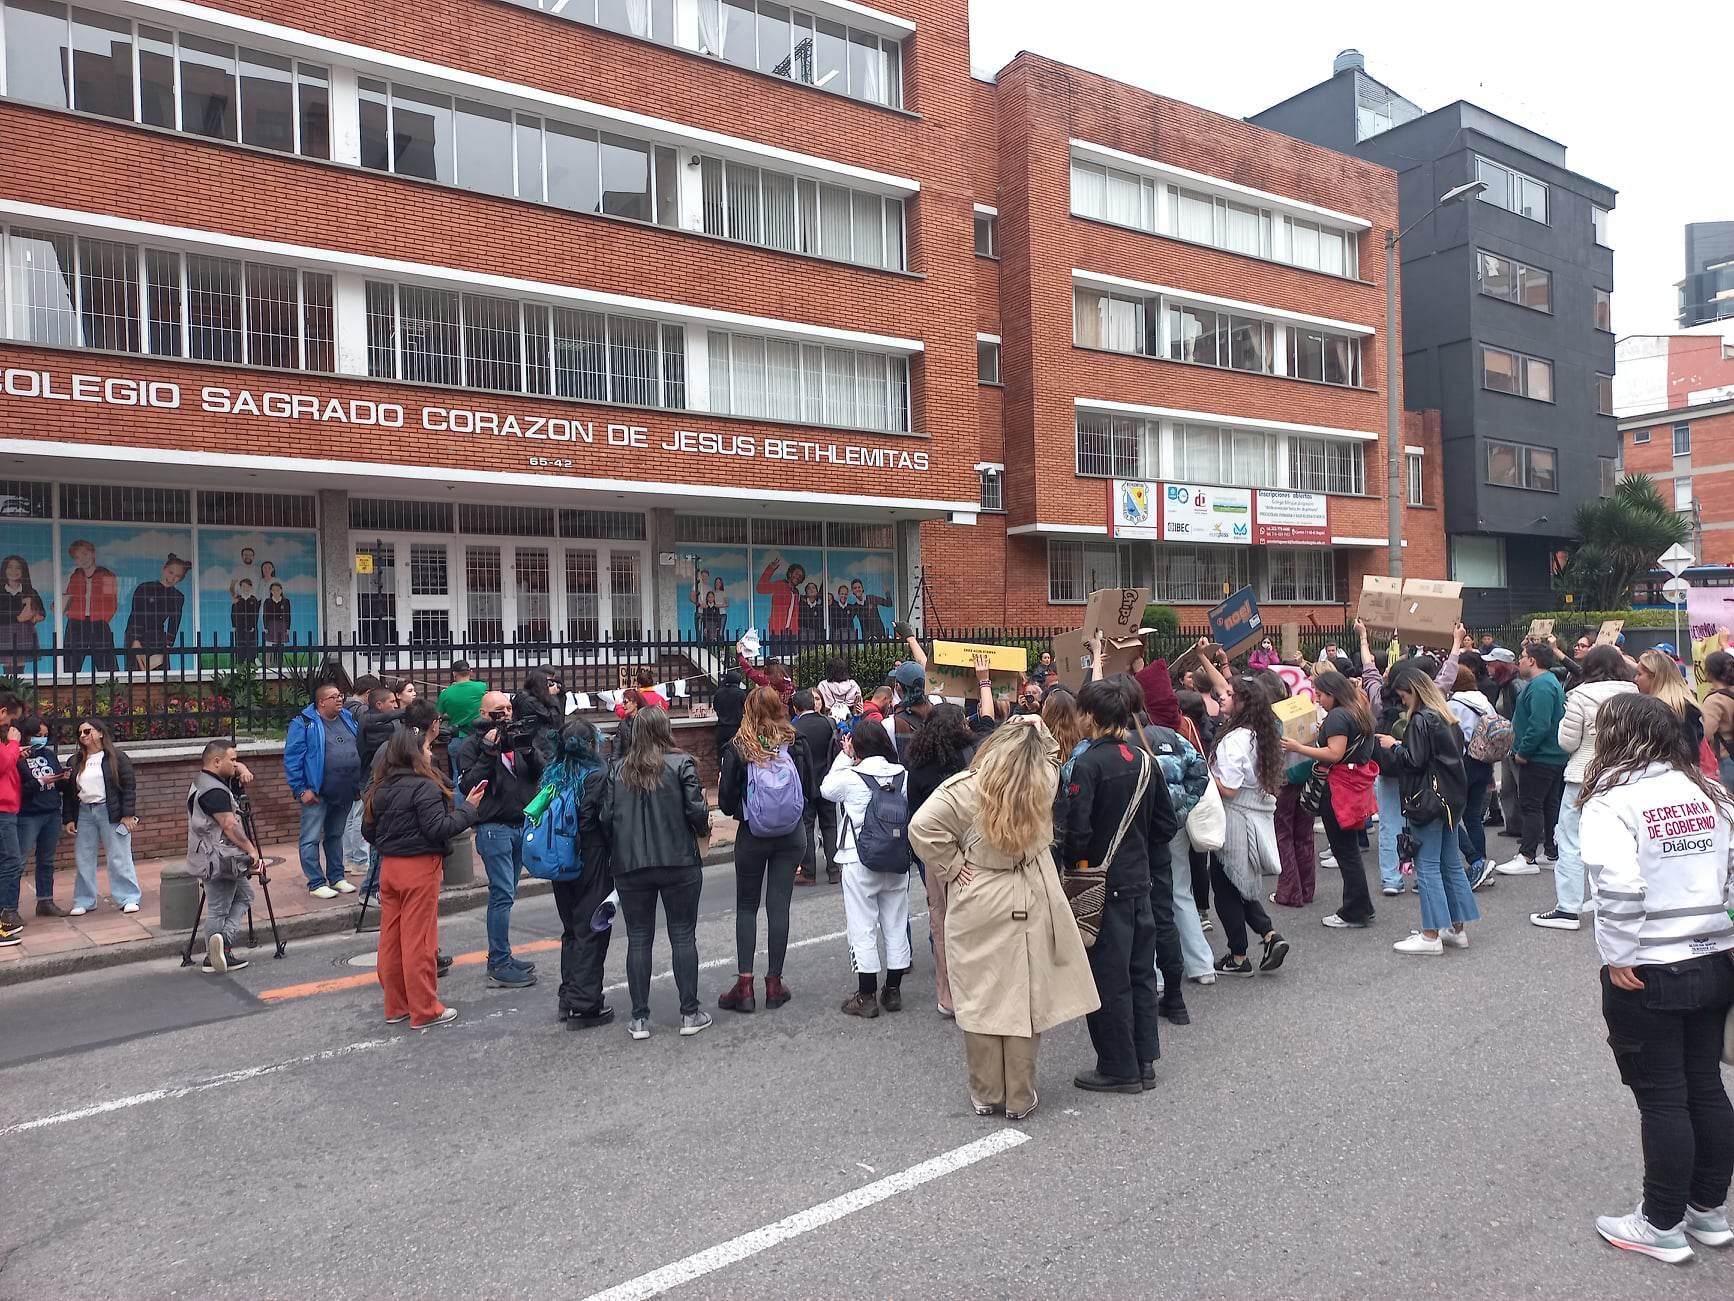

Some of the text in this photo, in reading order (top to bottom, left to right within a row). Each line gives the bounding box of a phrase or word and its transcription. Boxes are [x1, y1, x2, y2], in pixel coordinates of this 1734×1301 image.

[0, 367, 181, 409] OLEGIO
[201, 386, 404, 427] SAGRADO
[422, 406, 593, 443] CORAZON
[607, 423, 649, 448] DE
[764, 438, 930, 471] BETHLEMITAS
[529, 457, 574, 468] 65-42
[1118, 588, 1139, 625] Chips
[1647, 815, 1716, 840] DE GOBIERNO
[1662, 838, 1713, 853] Diálogo
